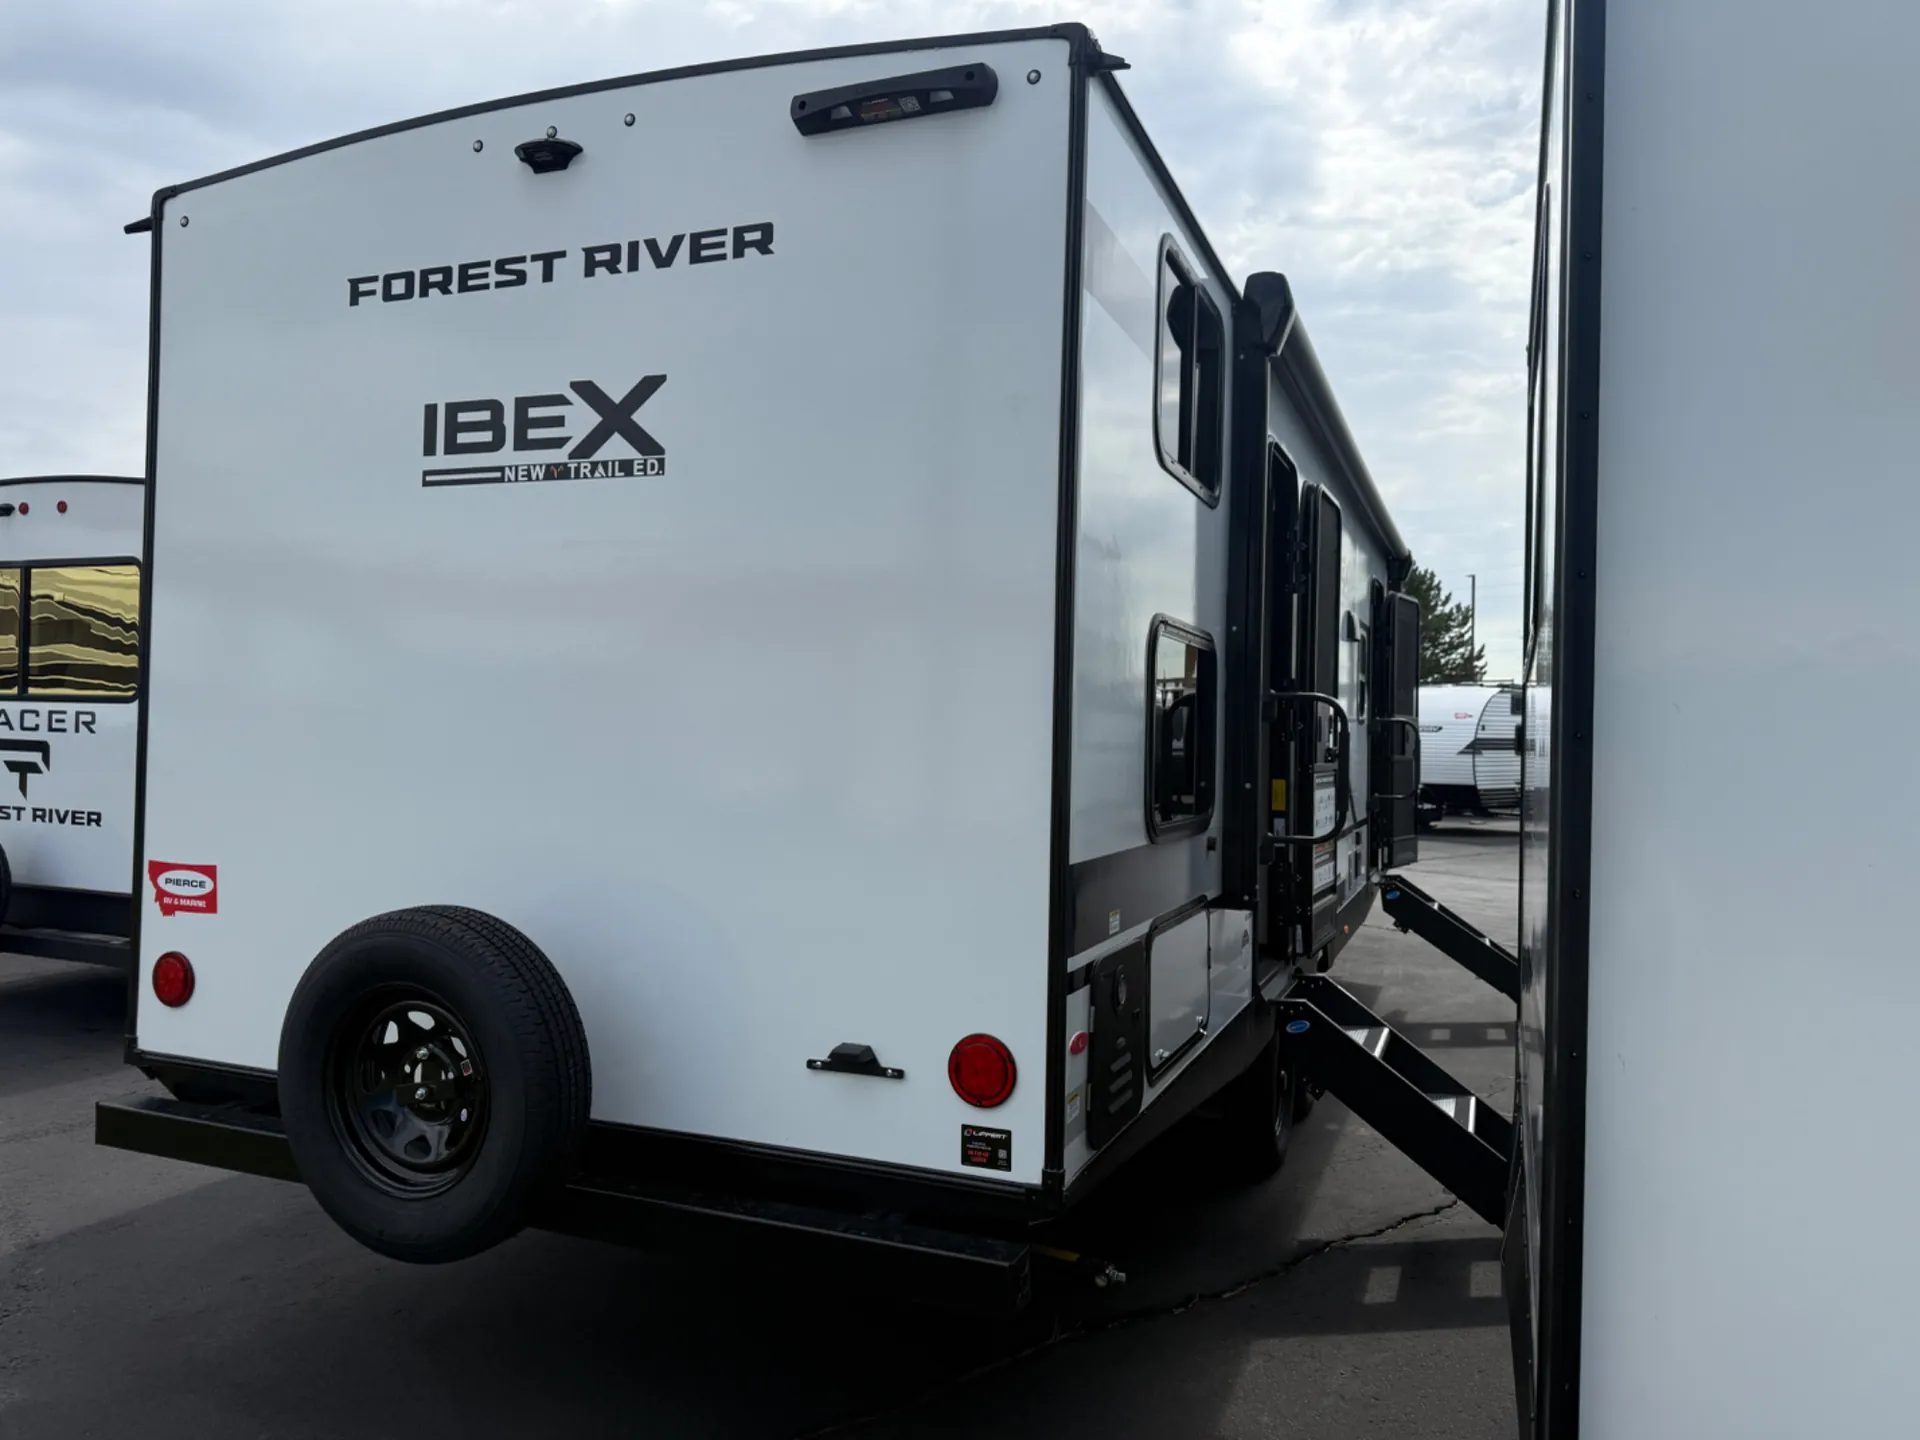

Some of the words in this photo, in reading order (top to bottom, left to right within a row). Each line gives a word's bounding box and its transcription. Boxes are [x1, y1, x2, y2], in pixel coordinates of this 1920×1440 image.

[347, 250, 567, 307] FOREST
[581, 221, 775, 278] RIVER
[423, 374, 667, 460] IBEX
[504, 464, 546, 482] NEW
[568, 460, 625, 479] TRAIL
[633, 458, 664, 476] ED.
[31, 807, 102, 827] RIVER
[164, 877, 207, 889] PIERCE
